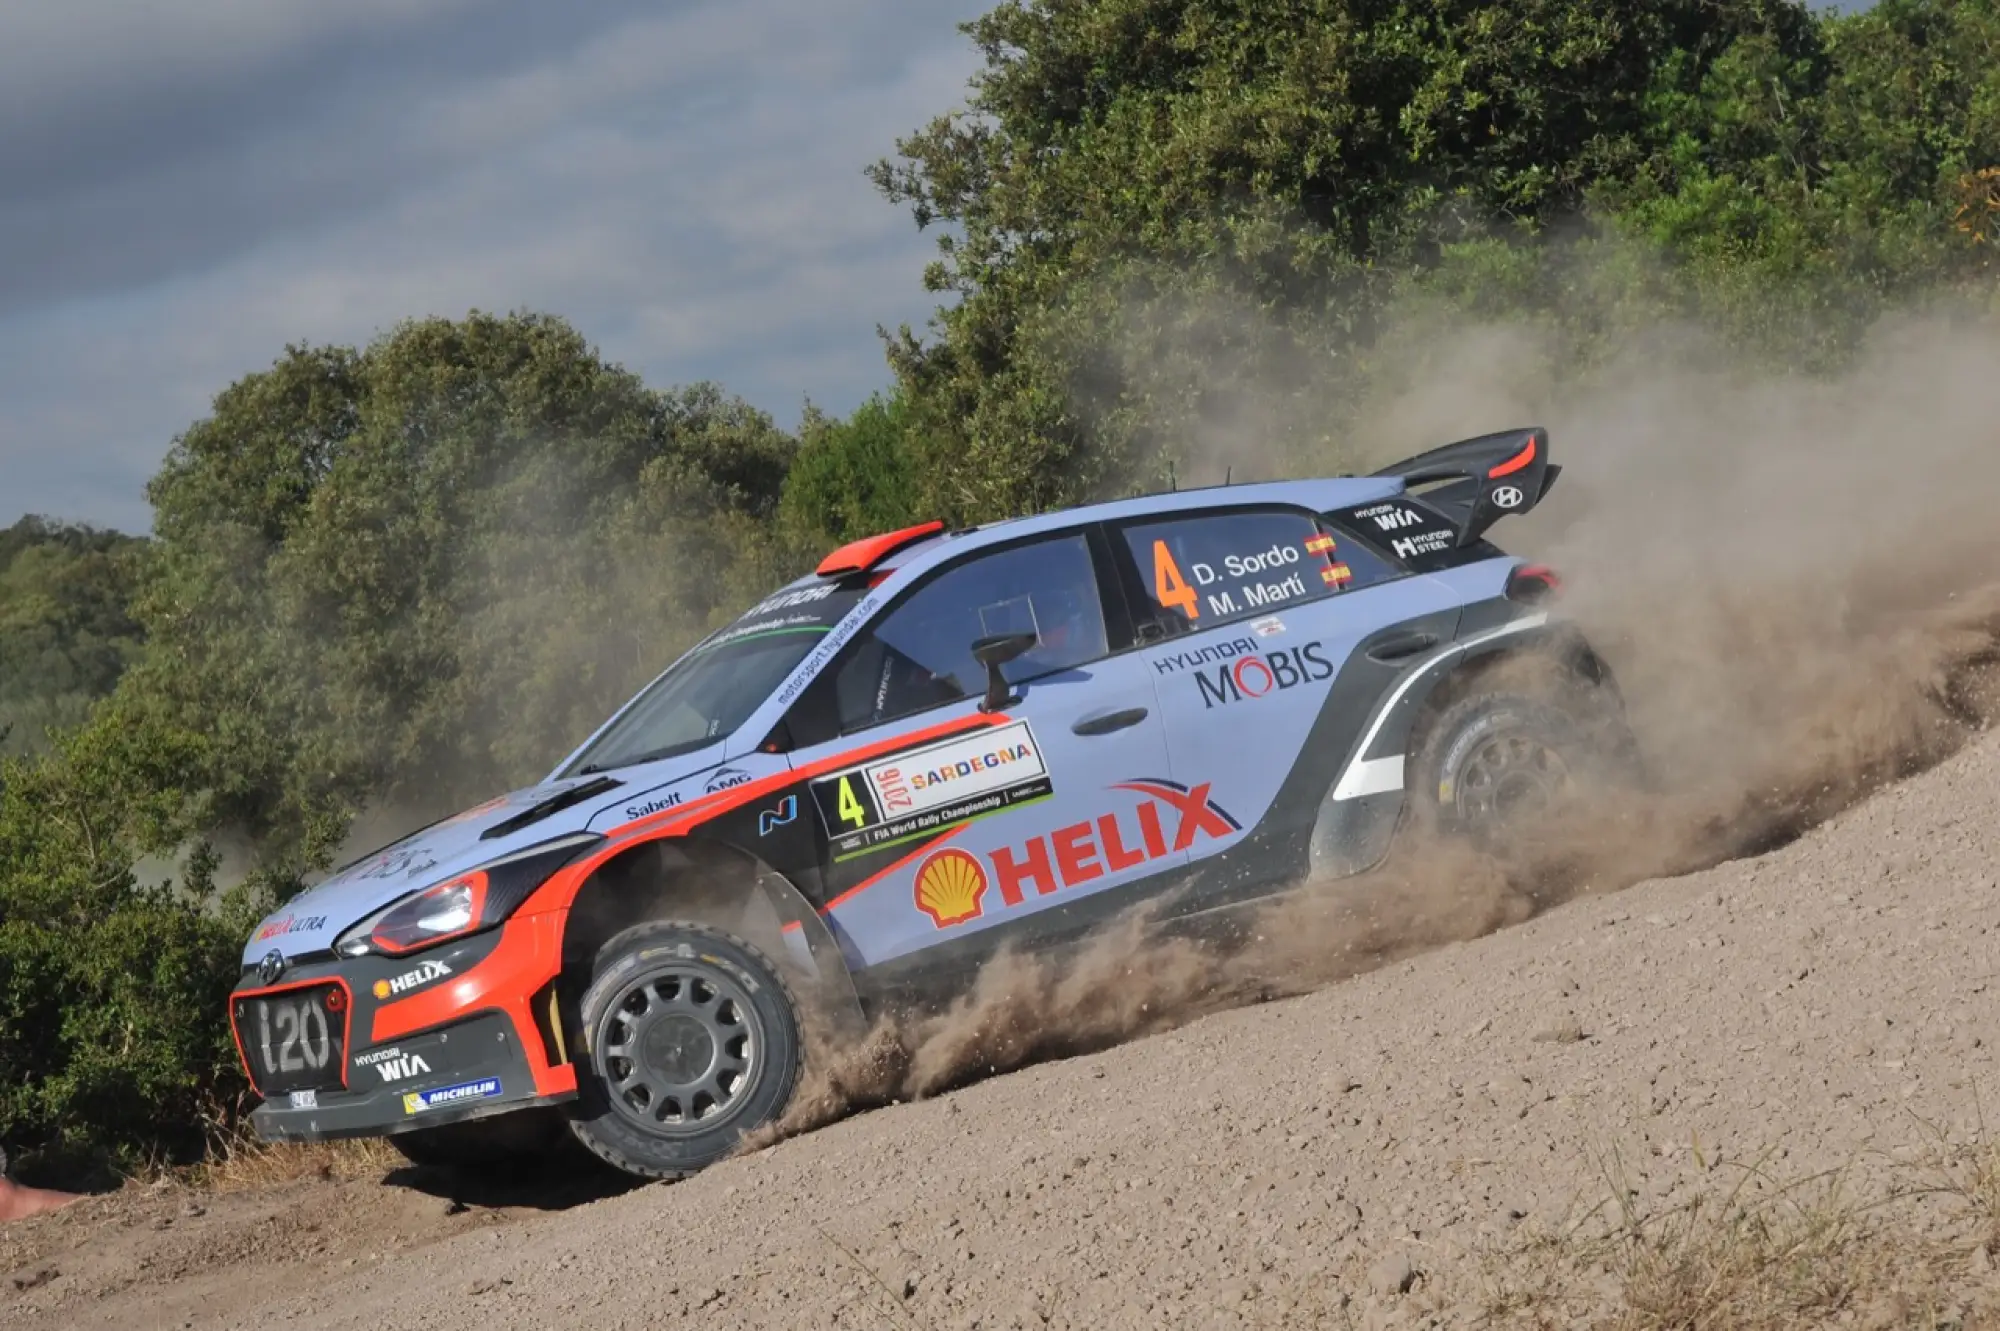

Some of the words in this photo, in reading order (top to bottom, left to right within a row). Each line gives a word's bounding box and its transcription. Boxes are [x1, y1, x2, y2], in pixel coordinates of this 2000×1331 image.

[1191, 563, 1223, 585] D.
[1224, 544, 1299, 577] Sordo
[1417, 538, 1449, 553] STEEL
[1153, 539, 1200, 620] 4
[1207, 591, 1243, 616] M.
[1242, 571, 1306, 607] Martí
[777, 597, 880, 705] motorsport.hyundai.com
[1153, 636, 1260, 675] HYUNDAI
[1193, 640, 1334, 709] MOBIS
[911, 743, 1032, 790] SARDEGNA
[625, 791, 683, 820] Sabelt
[838, 775, 865, 828] 4
[876, 767, 913, 811] 2016
[874, 828, 890, 841] FIA
[890, 820, 917, 836] World
[918, 814, 940, 828] Rally
[941, 796, 1001, 821] Championship
[987, 780, 1238, 907] HELIX
[390, 960, 453, 994] HELIX
[355, 1047, 401, 1067] HYUNDAI
[429, 1081, 496, 1104] MICHELIN
